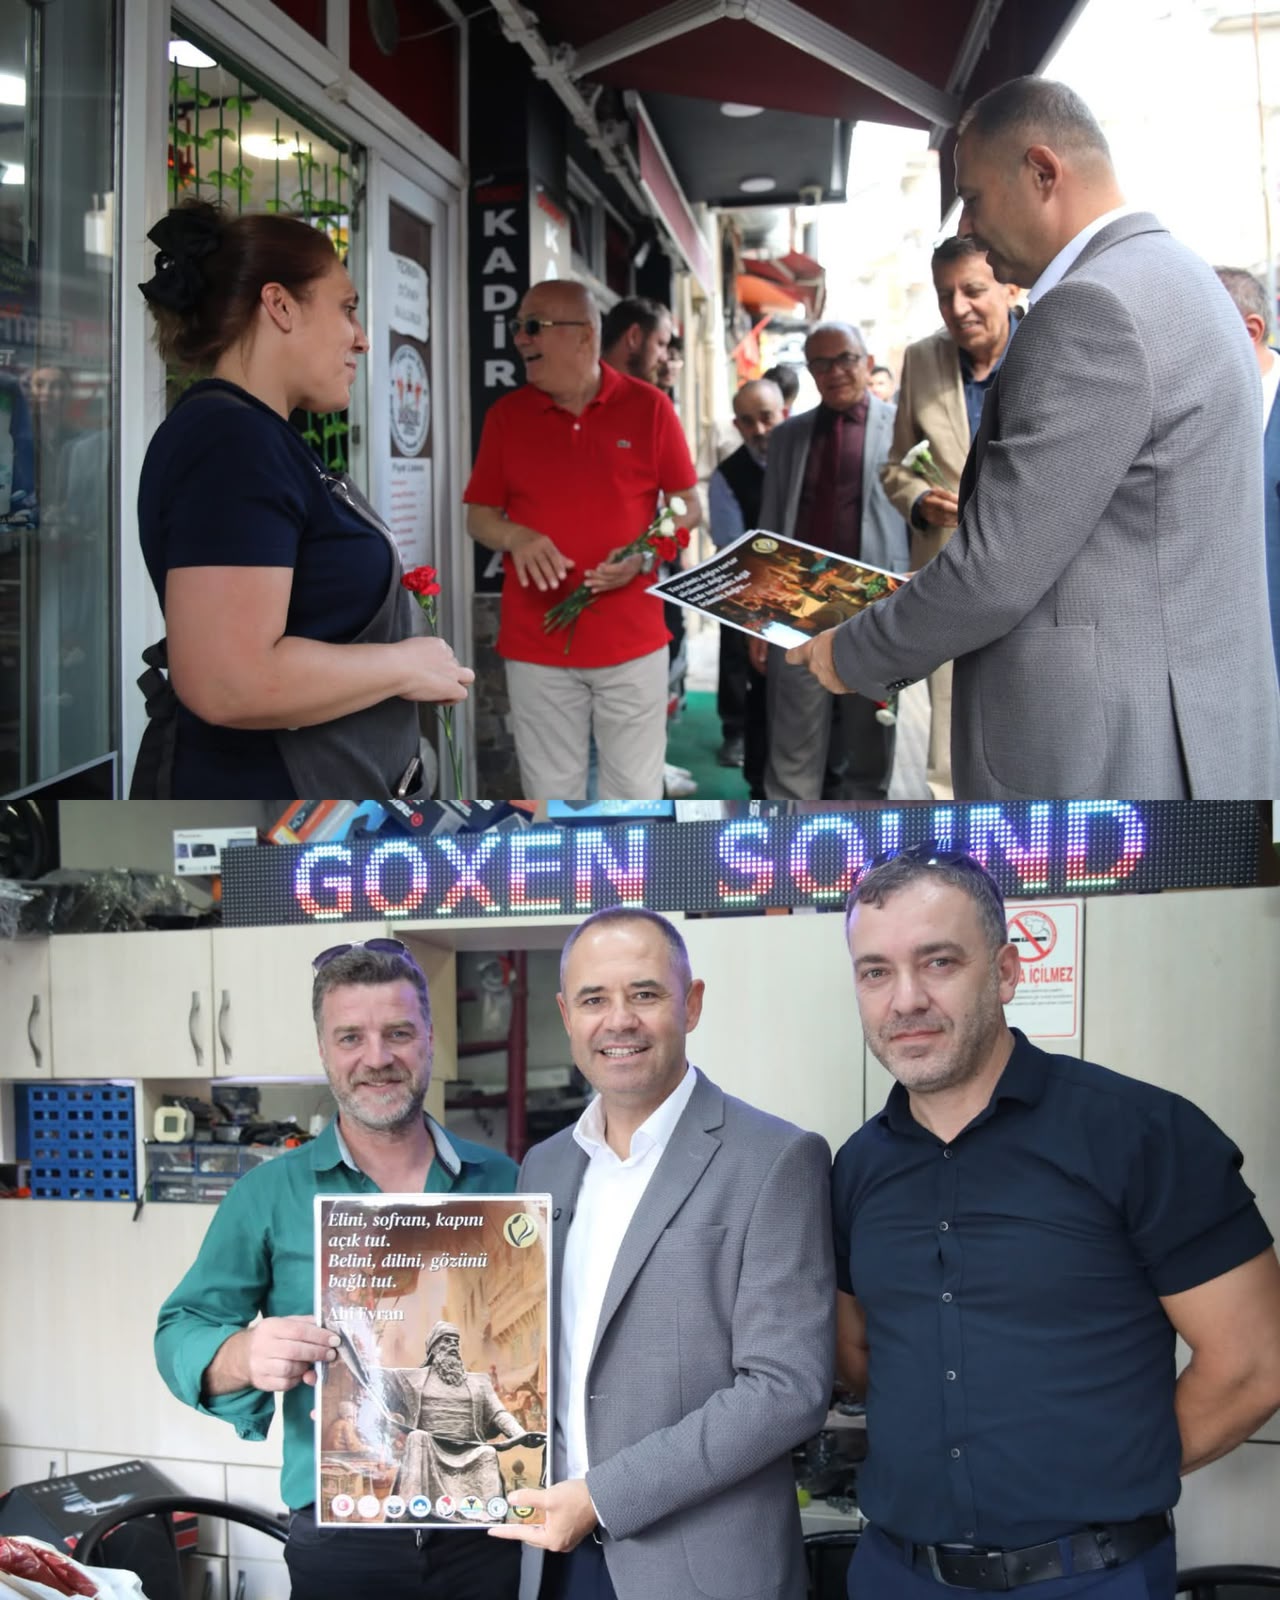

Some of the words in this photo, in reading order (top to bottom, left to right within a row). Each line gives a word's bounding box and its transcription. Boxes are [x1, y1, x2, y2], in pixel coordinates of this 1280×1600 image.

[295, 828, 645, 919] GOXEN
[328, 1212, 368, 1229] Elini,
[372, 1212, 431, 1230] sofranı,
[435, 1212, 484, 1230] kapını
[328, 1233, 360, 1249] açık
[364, 1235, 391, 1248] tut.
[328, 1253, 376, 1270] Belini,
[381, 1253, 425, 1270] dilini,
[429, 1253, 488, 1272] gözünü
[328, 1274, 366, 1291] bağlı
[370, 1276, 397, 1288] tut.
[329, 1306, 354, 1321] Ahi
[355, 1306, 404, 1322] Evran
